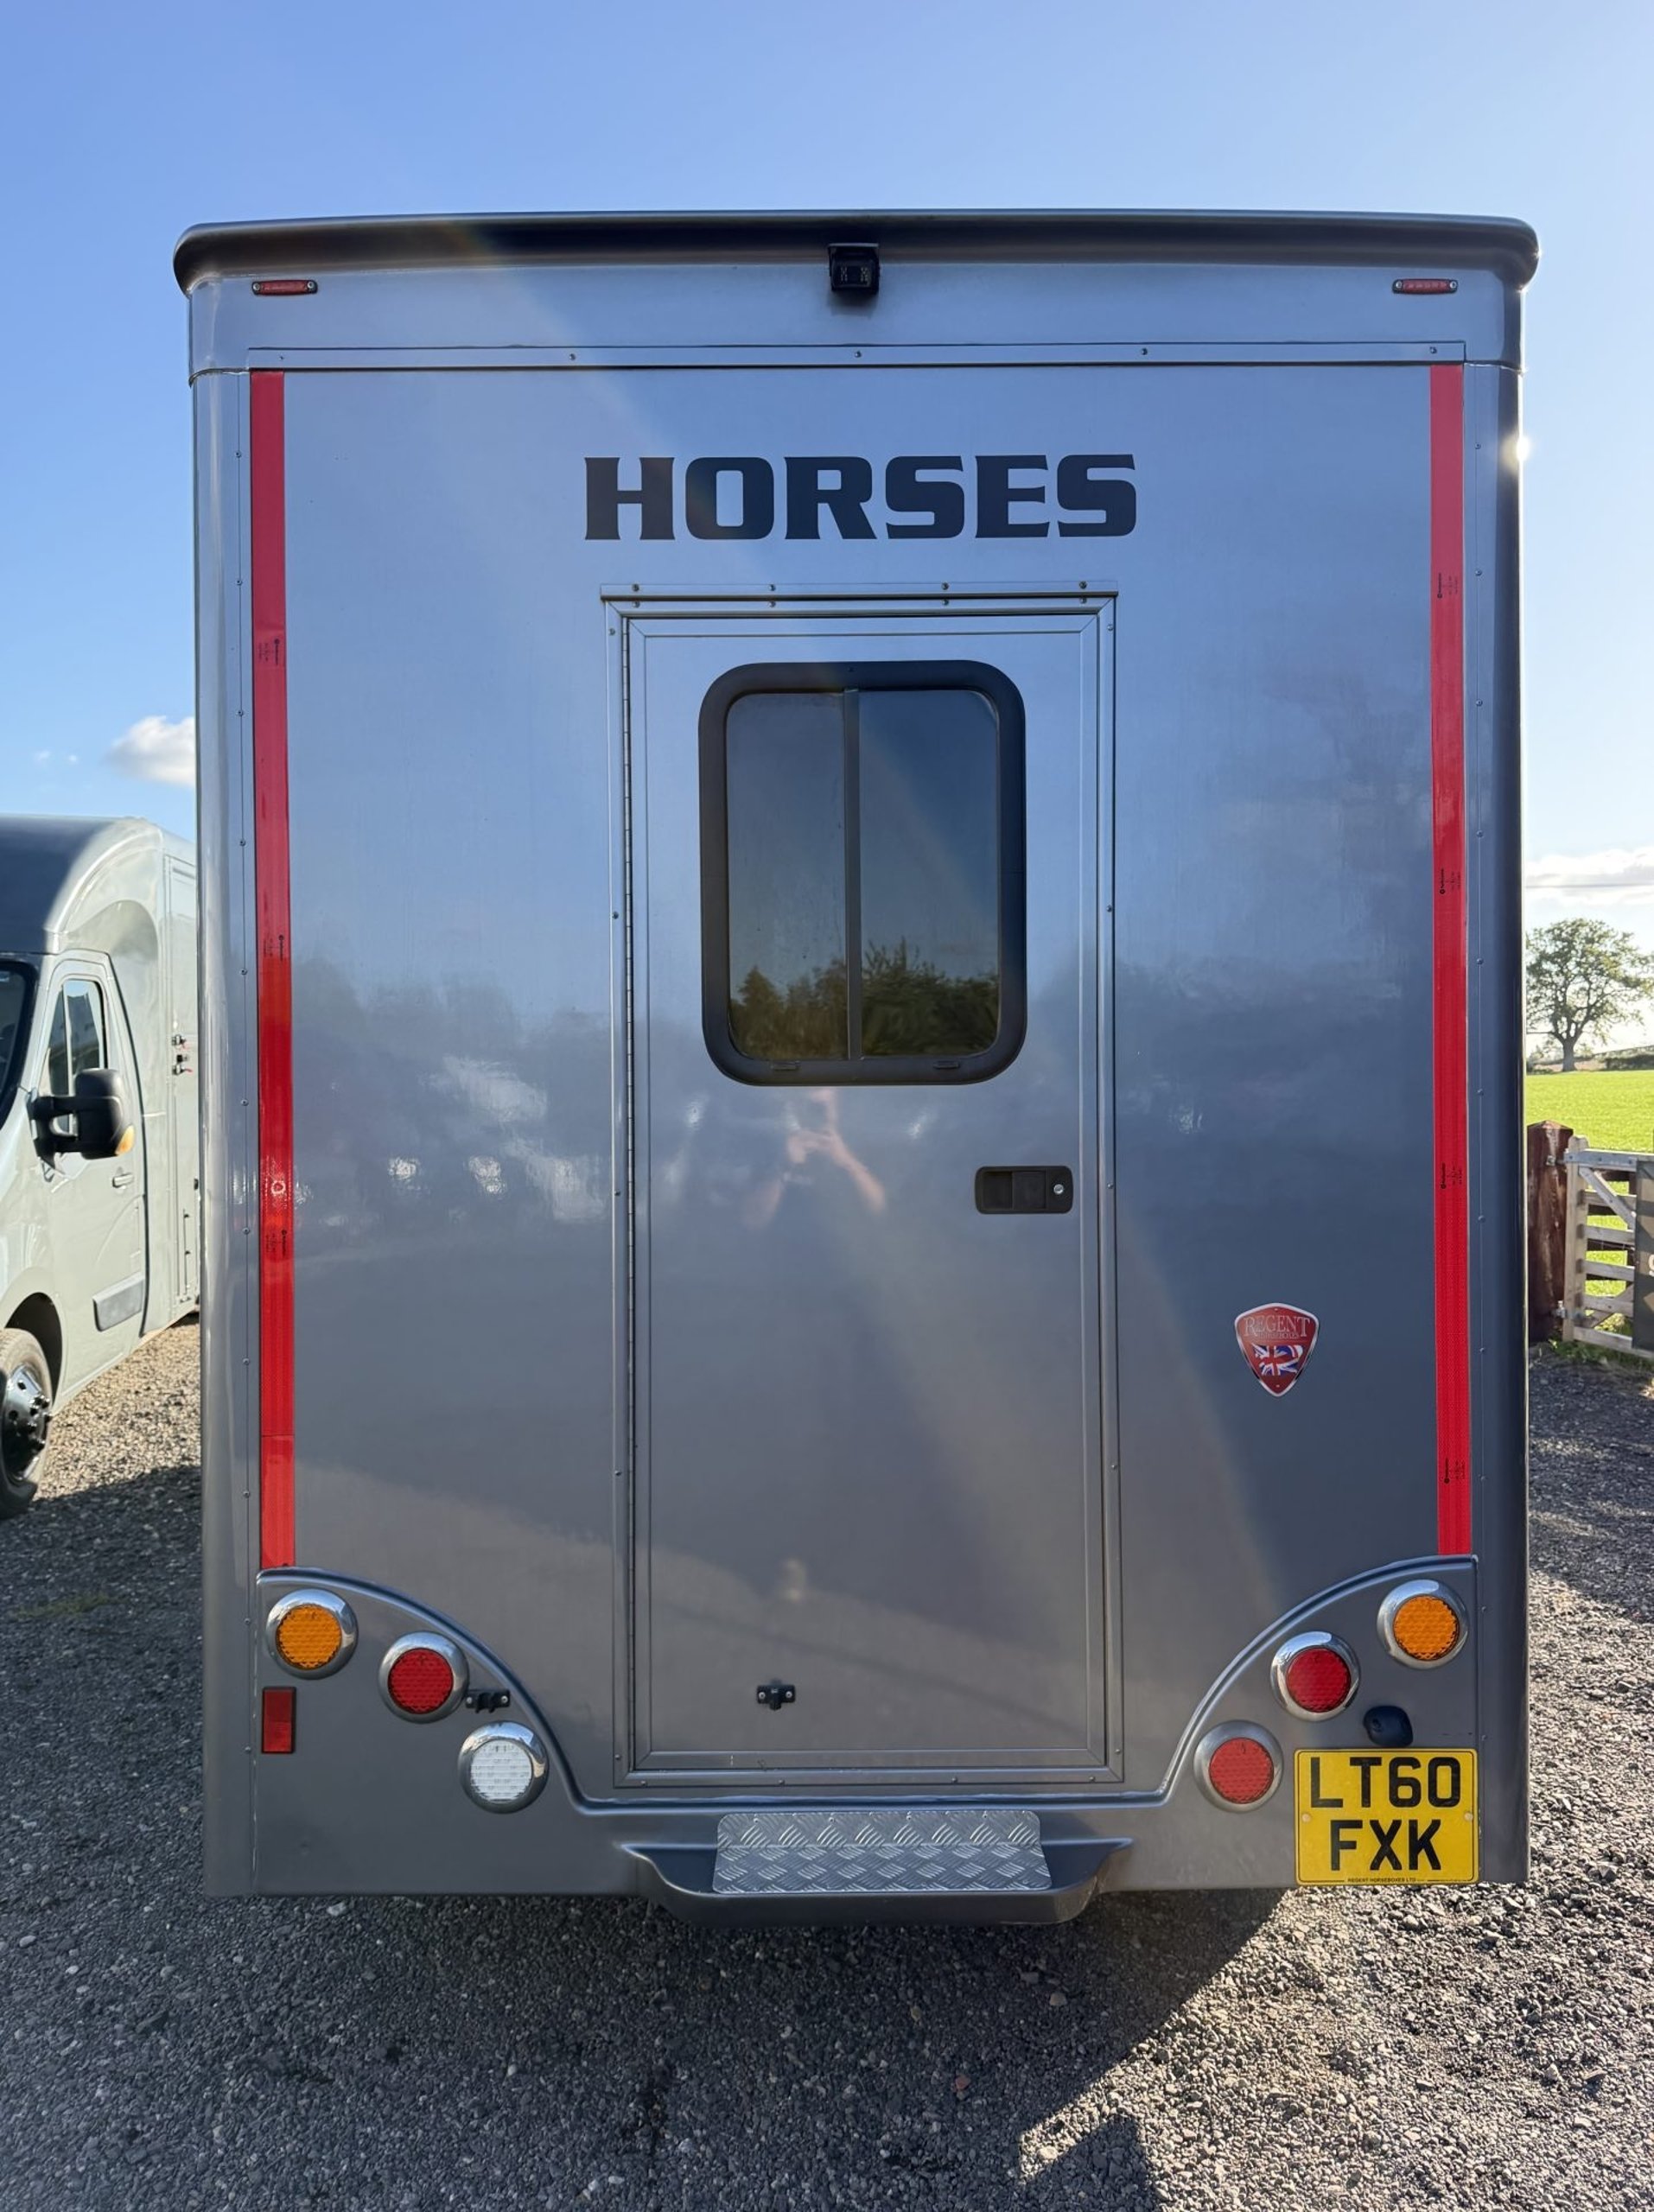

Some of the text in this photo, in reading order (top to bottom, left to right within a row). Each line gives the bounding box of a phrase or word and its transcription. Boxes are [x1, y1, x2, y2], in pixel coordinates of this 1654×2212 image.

[584, 454, 1137, 540] HORSES
[1244, 1315, 1311, 1337] REGENT
[1310, 1757, 1461, 1808] LT60
[1330, 1819, 1441, 1872] FXK
